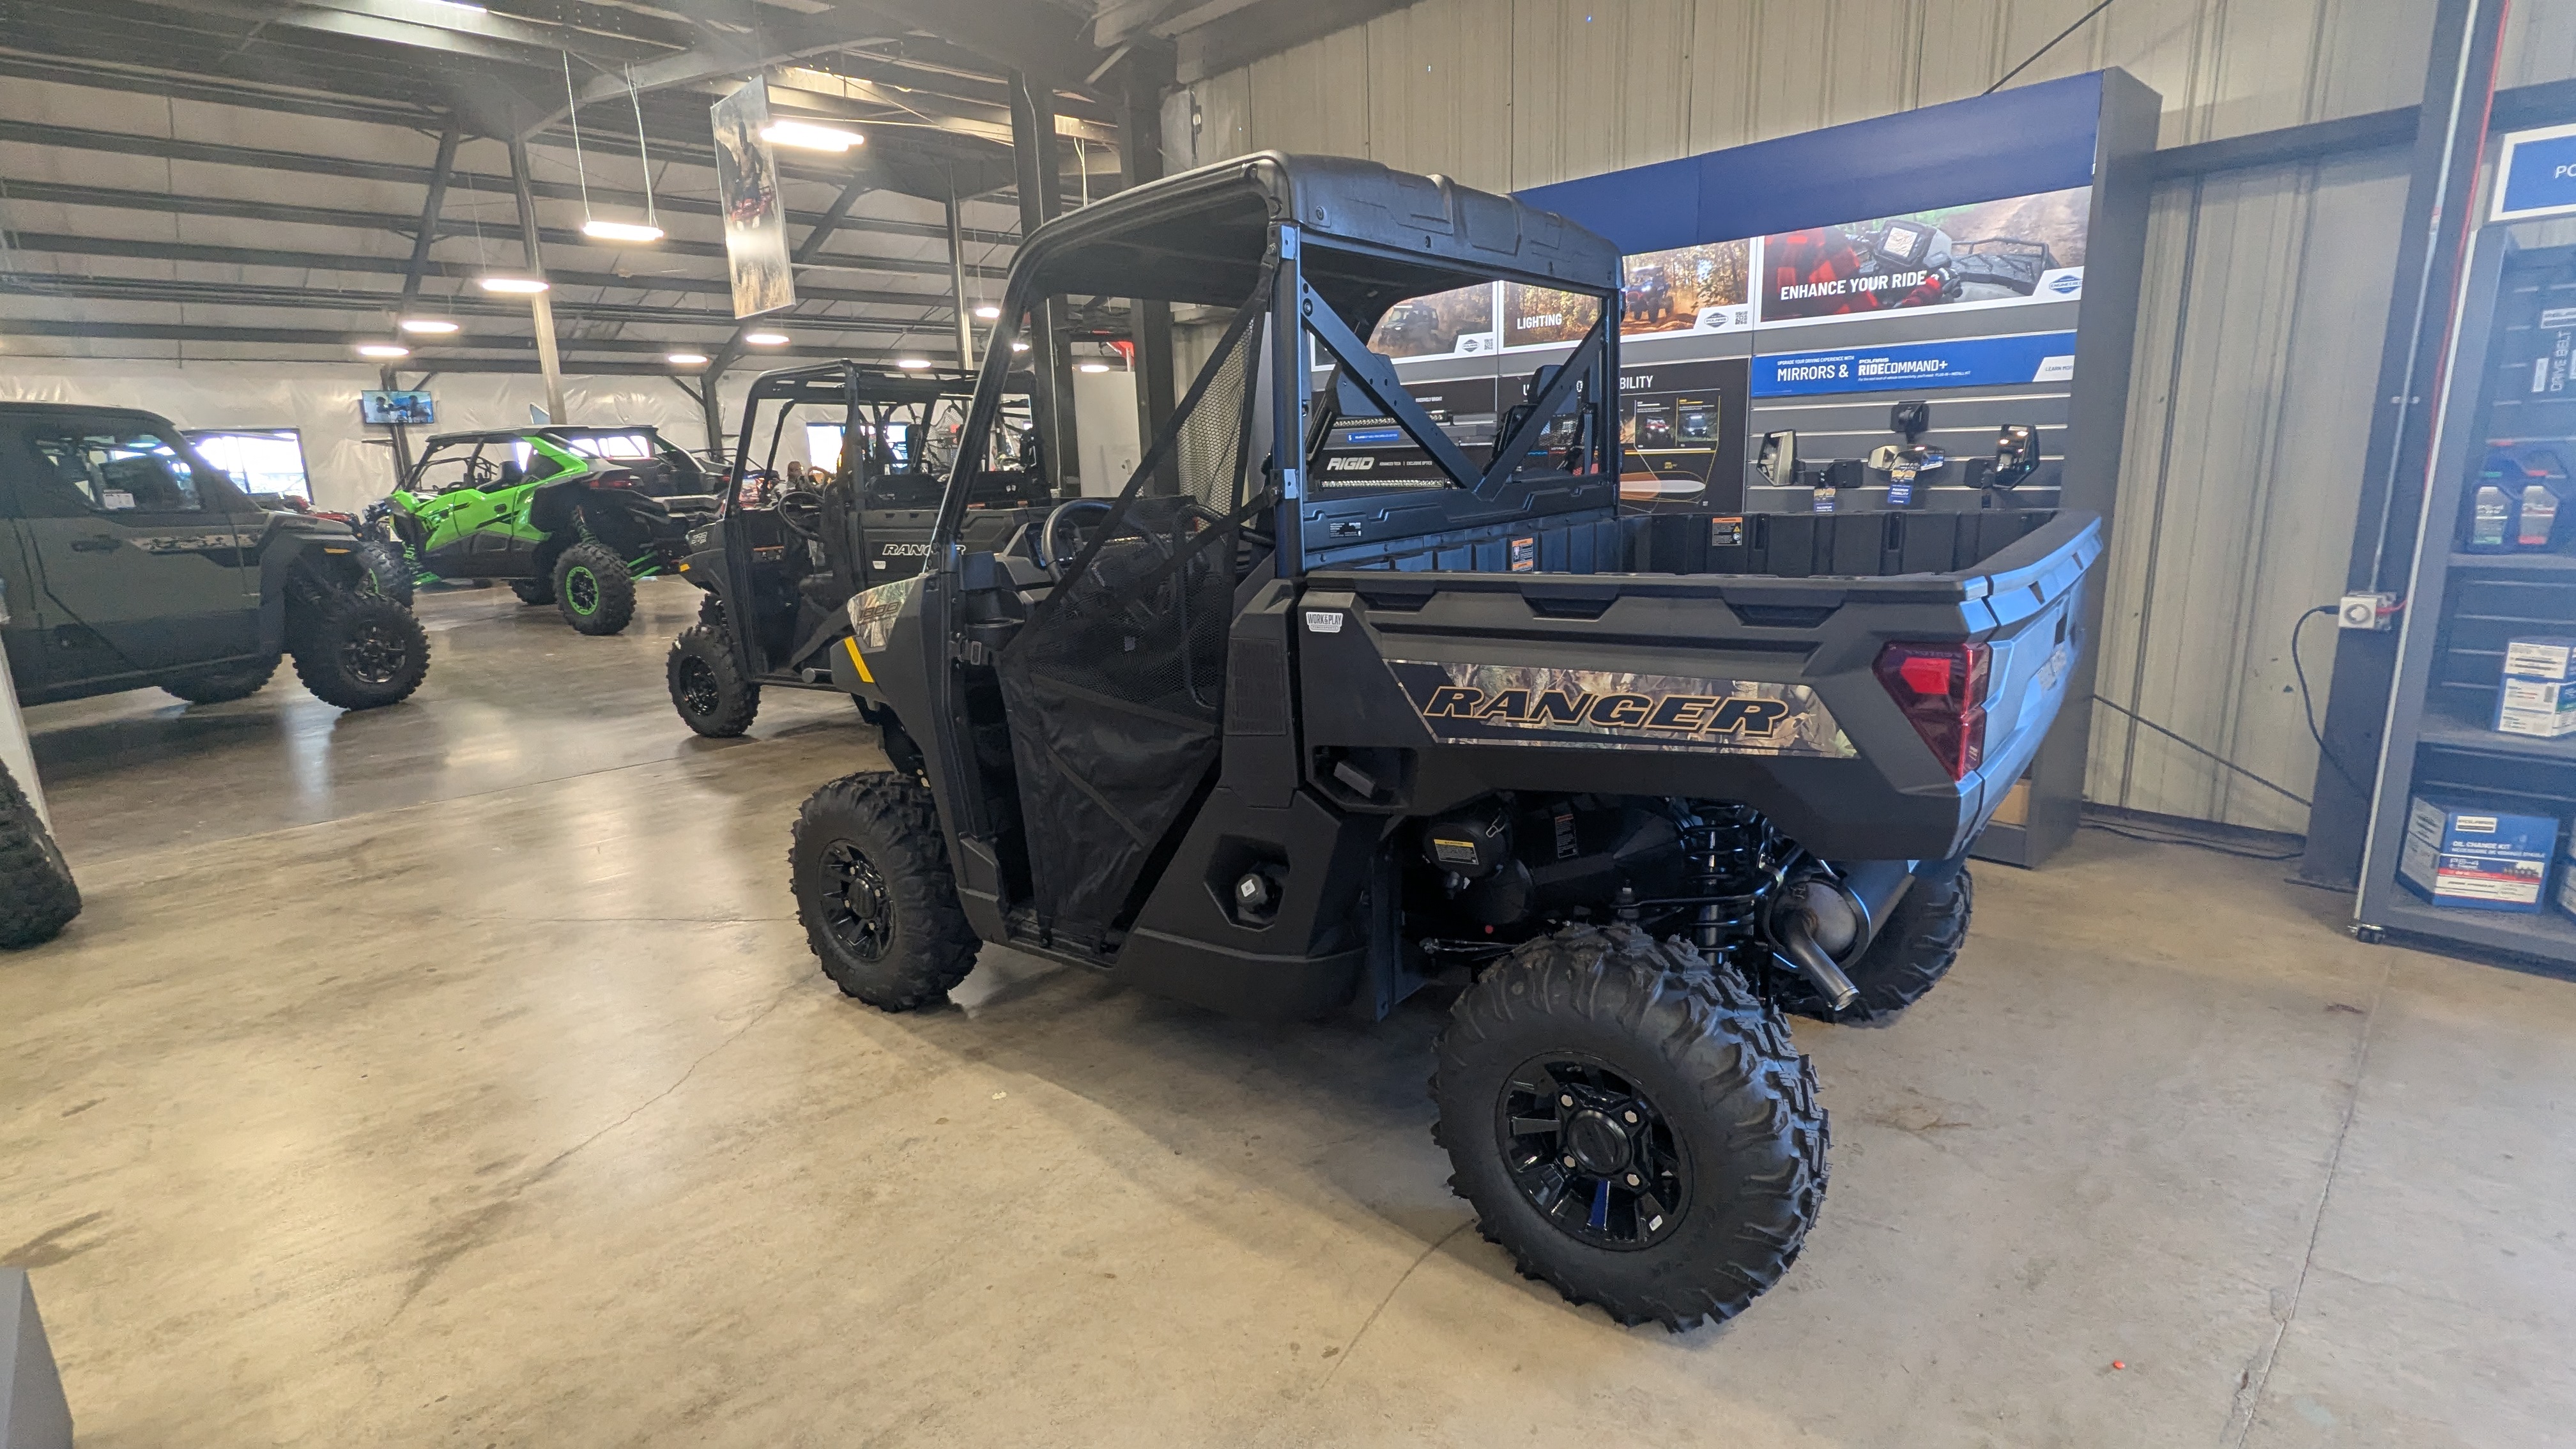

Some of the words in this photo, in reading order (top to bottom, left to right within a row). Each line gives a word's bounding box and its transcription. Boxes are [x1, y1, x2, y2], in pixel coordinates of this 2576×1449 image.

[1781, 279, 1846, 301] ENHANCE
[1850, 274, 1889, 293] YOUR
[1892, 270, 1928, 289] RIDE
[1517, 313, 1562, 330] LIGHTING
[1777, 365, 1836, 382] MIRRORS
[1838, 364, 1849, 378] &
[1326, 457, 1375, 471] RIGID
[882, 544, 967, 556] RANR
[859, 601, 901, 620] 1000
[1423, 686, 1790, 737] RANGER
